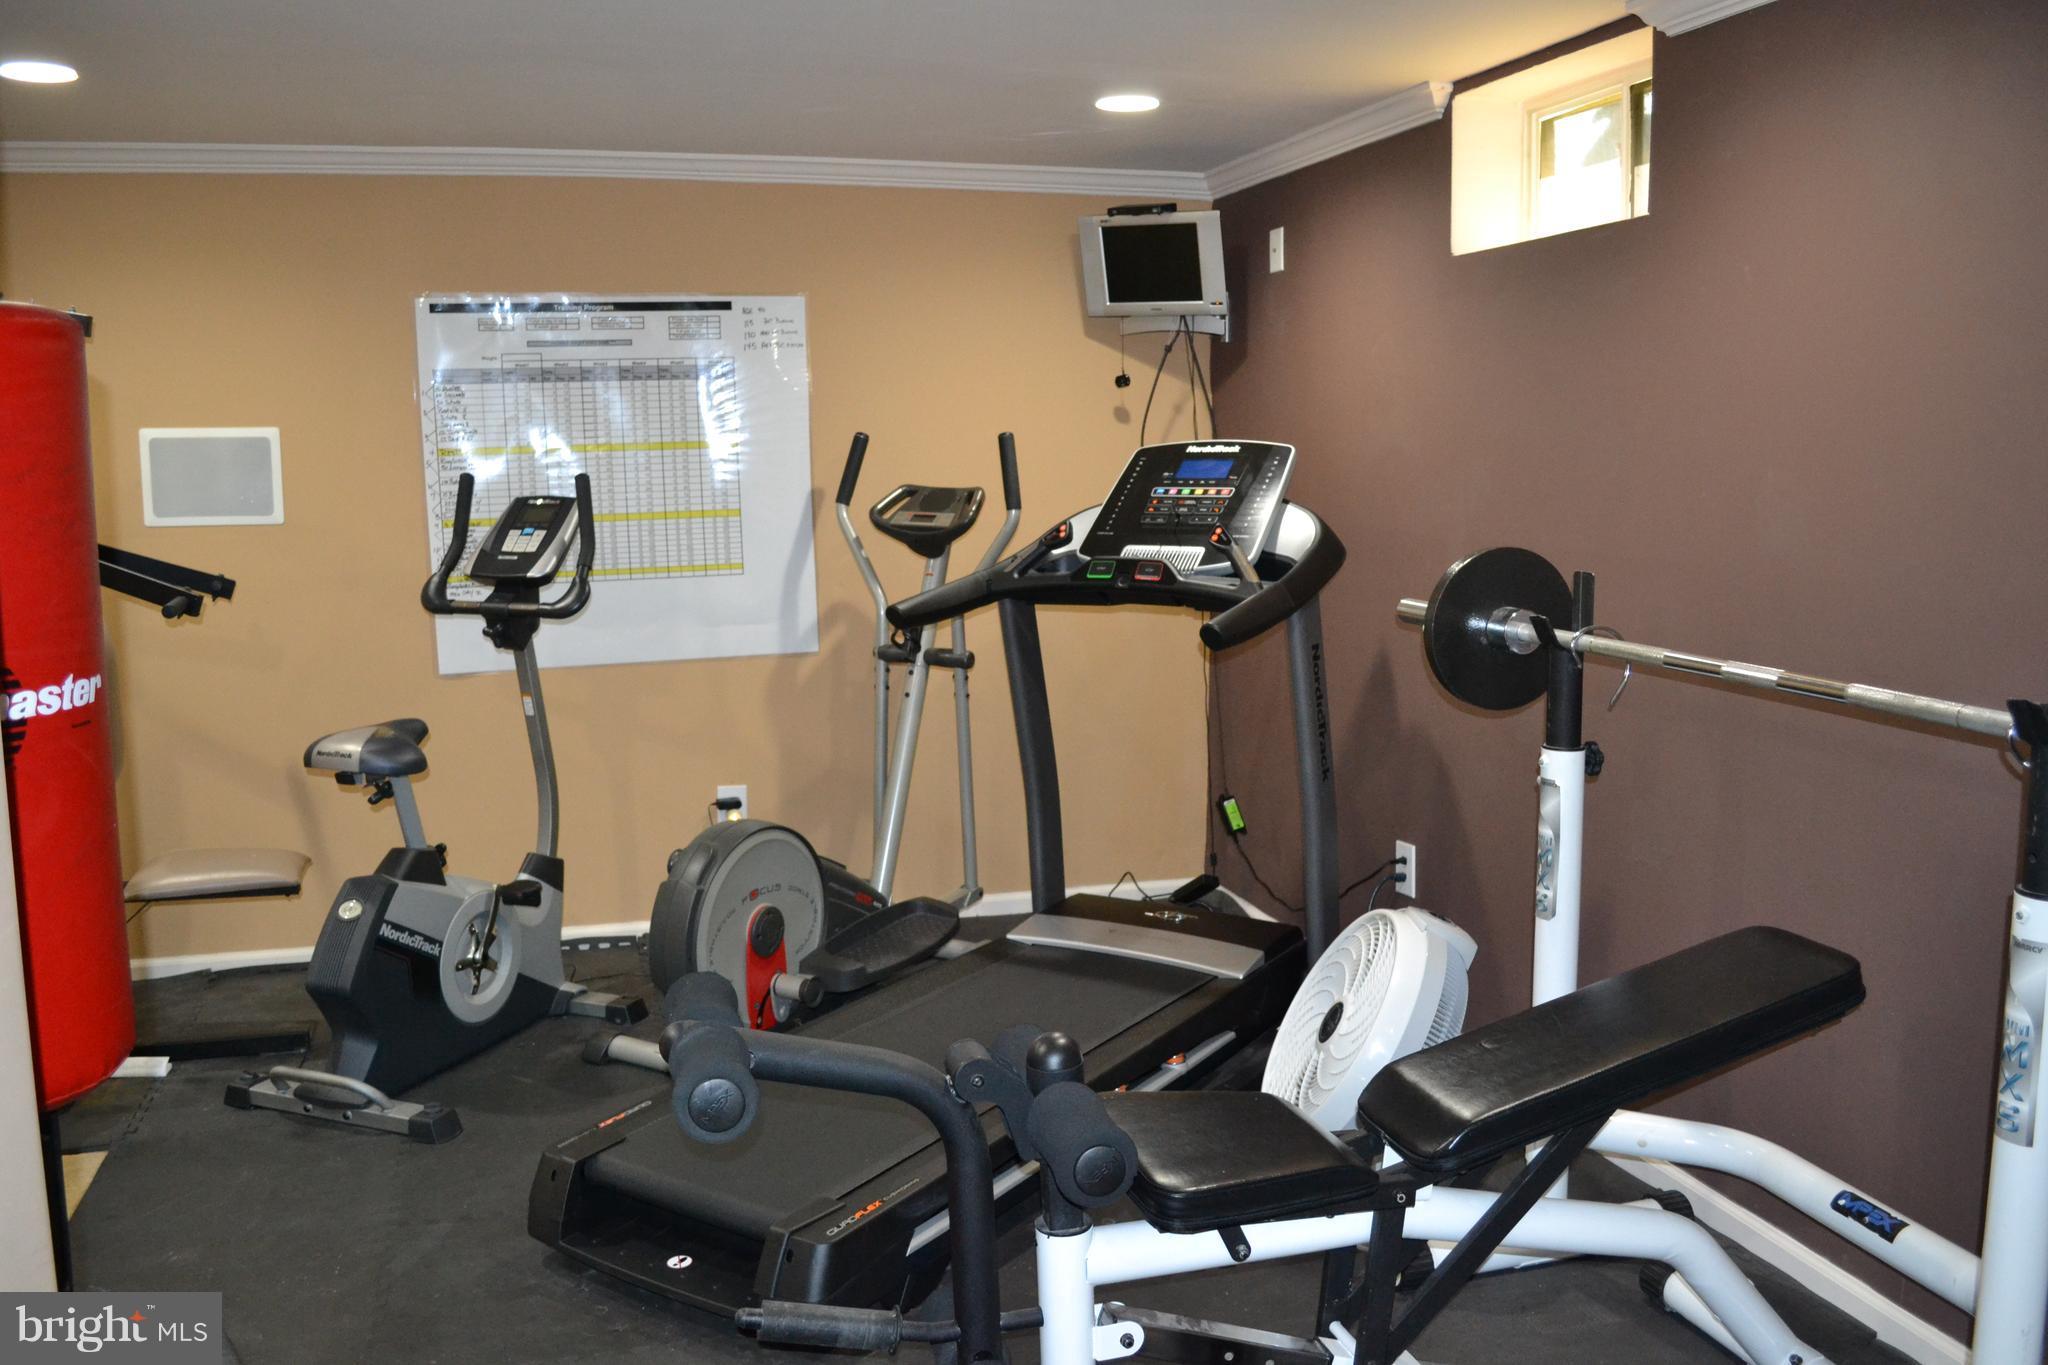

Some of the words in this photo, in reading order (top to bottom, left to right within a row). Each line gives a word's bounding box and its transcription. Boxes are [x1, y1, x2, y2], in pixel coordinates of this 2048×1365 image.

[584, 302, 614, 312] Program
[1312, 643, 1330, 782] NordicTrack
[316, 750, 353, 759] NordicTrack
[379, 922, 441, 957] NordicTrack
